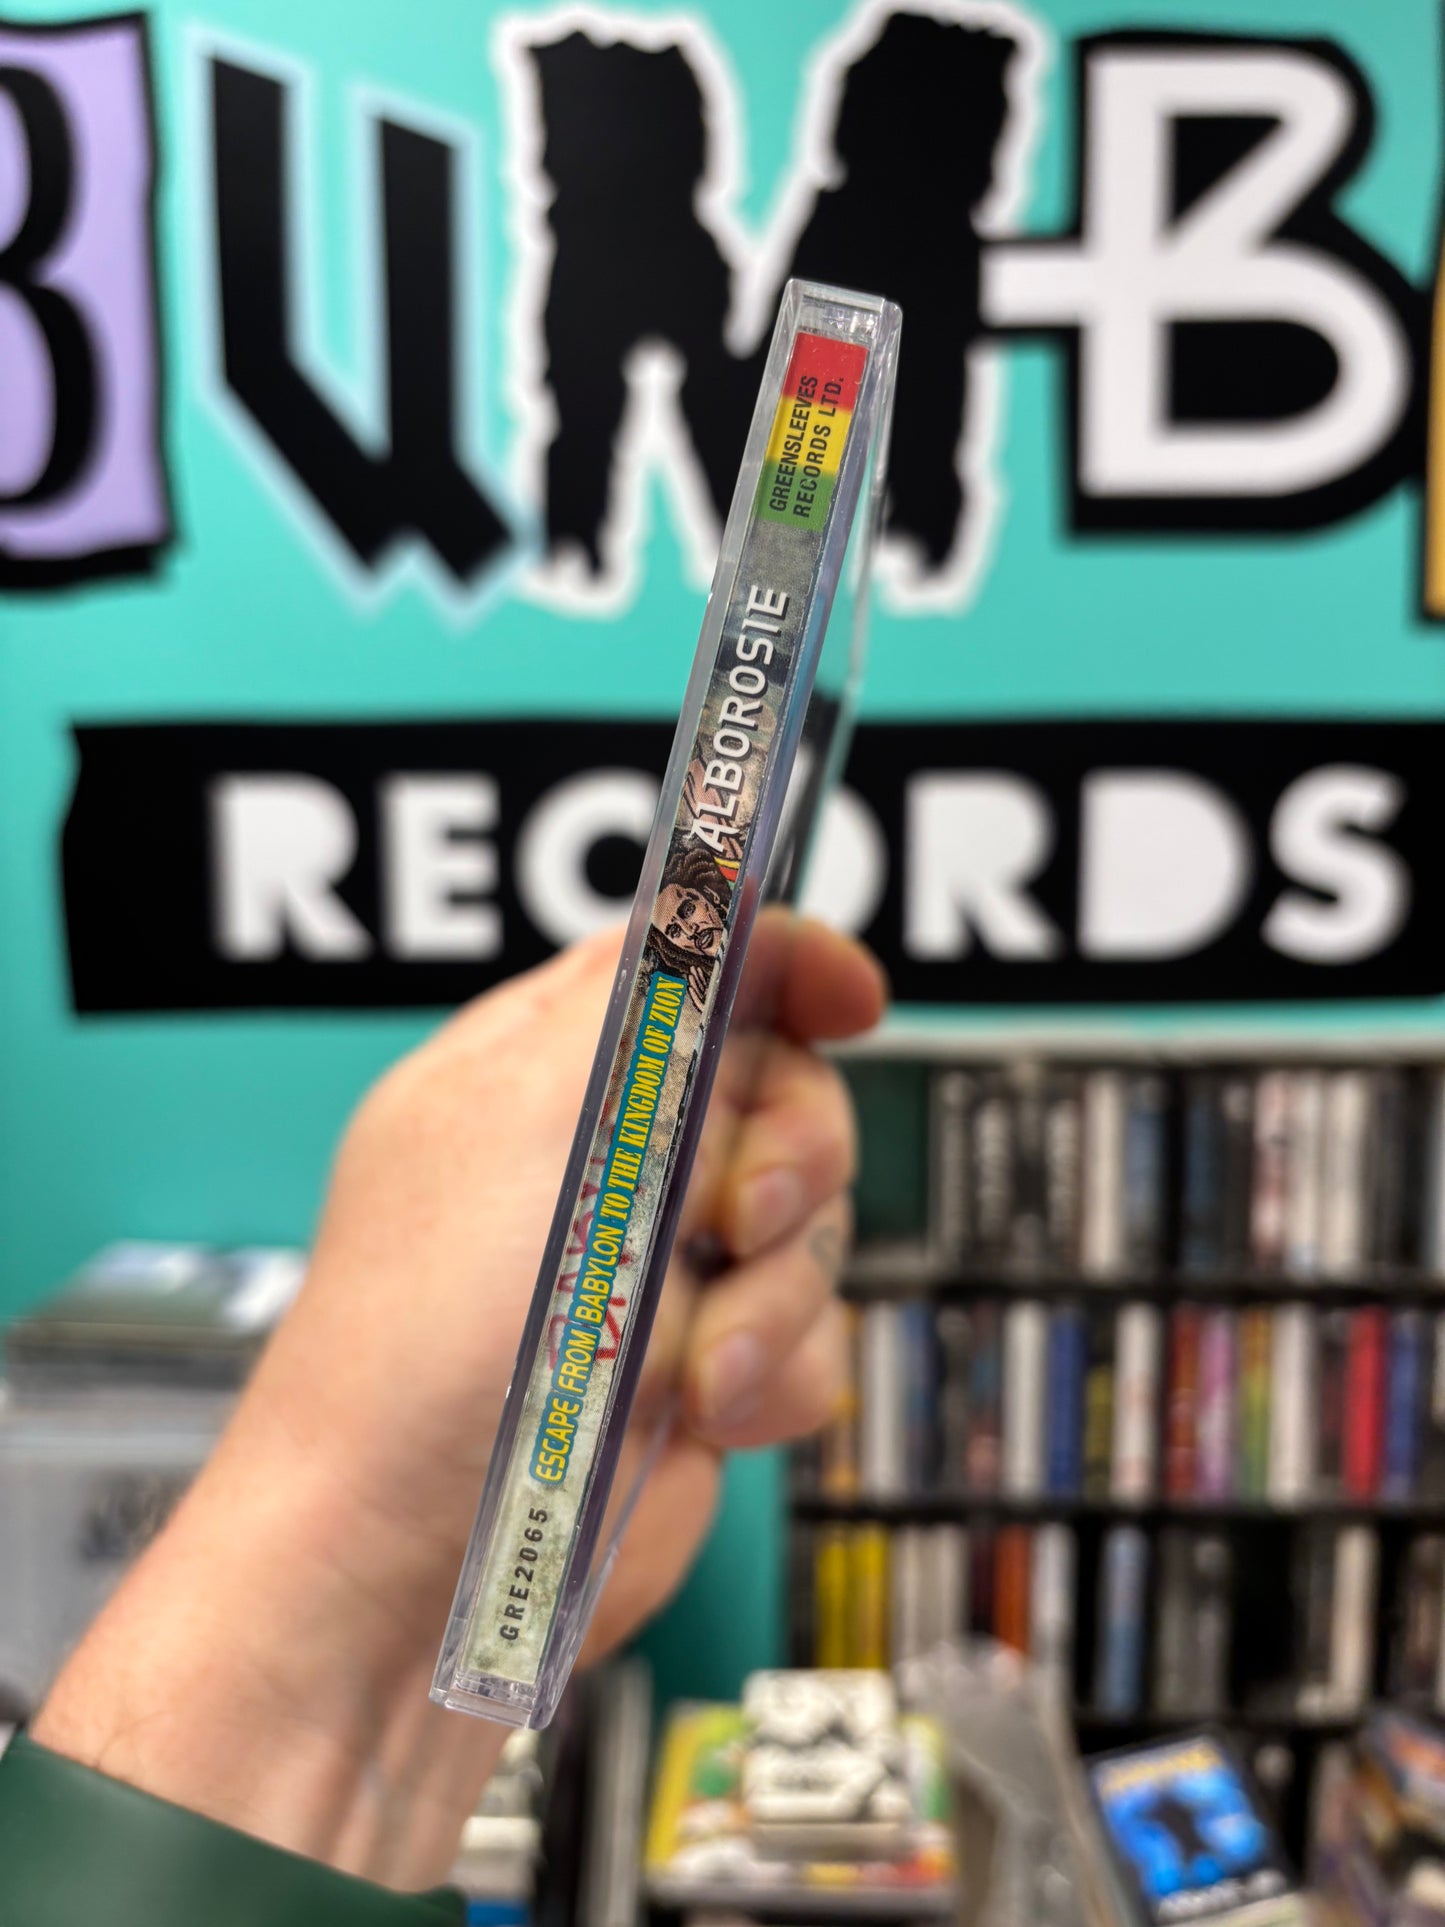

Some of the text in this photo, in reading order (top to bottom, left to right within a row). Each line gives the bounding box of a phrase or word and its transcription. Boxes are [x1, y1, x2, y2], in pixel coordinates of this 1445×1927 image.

[768, 375, 818, 511] GREENSLEEVES
[793, 377, 844, 518] RECORDS LTD.
[689, 584, 789, 853] ALBOROSIE
[642, 1024, 673, 1055] OF
[648, 976, 685, 1028] ZION
[618, 1053, 666, 1149] KINGDOM
[600, 1191, 631, 1220] TO
[607, 1147, 643, 1192] THE
[575, 1223, 625, 1323] BABYLON
[558, 1328, 597, 1393] FROM
[535, 1397, 579, 1482] ESCAPE
[500, 1508, 548, 1641] GRE2065
